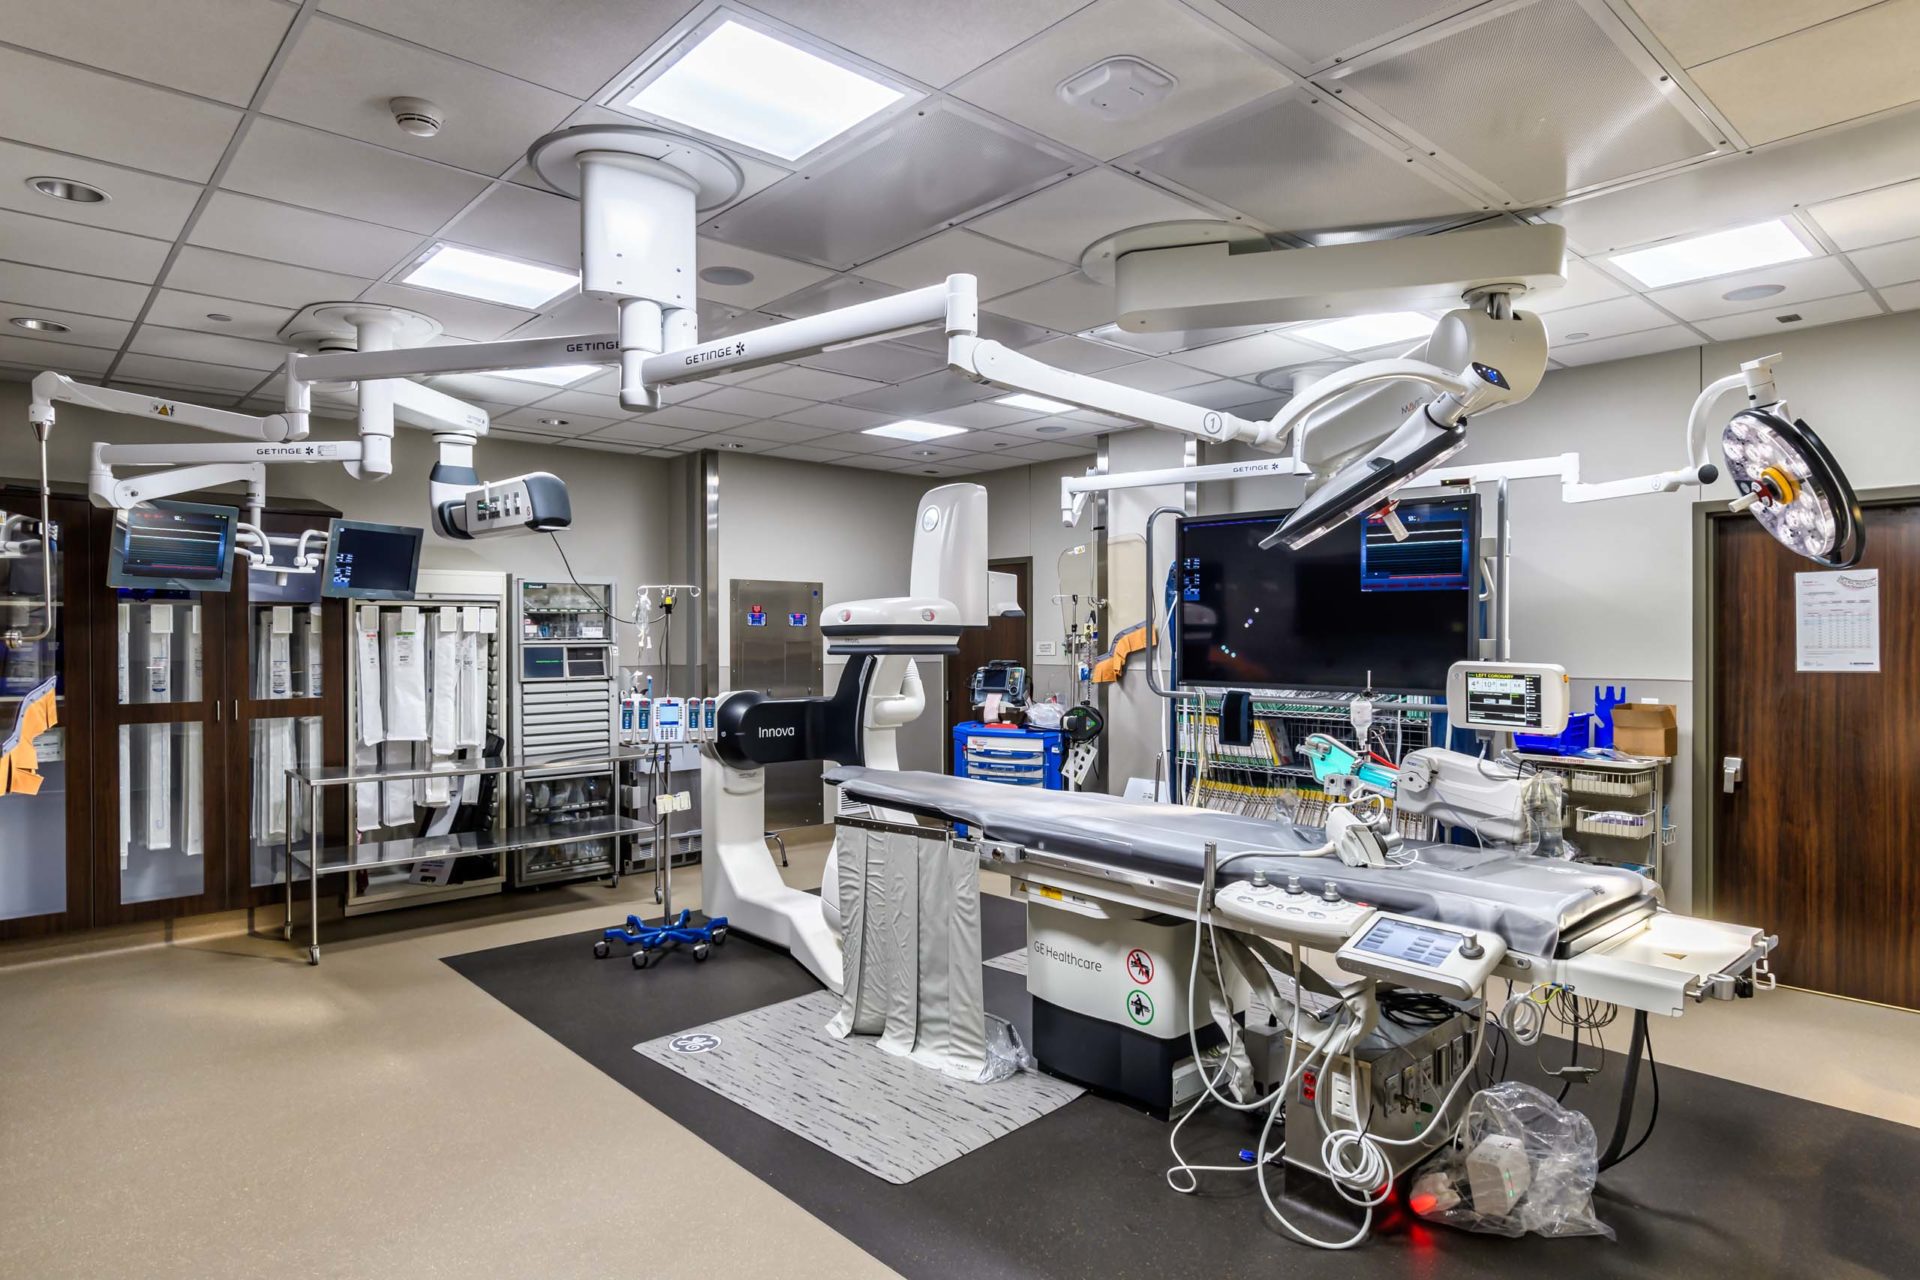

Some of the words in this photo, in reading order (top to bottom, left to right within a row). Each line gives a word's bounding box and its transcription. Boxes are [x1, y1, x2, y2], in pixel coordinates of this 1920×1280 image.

[685, 346, 732, 365] GETINGE
[1232, 464, 1269, 473] GETINGE
[758, 726, 795, 739] Innova
[1033, 940, 1045, 955] GE
[1046, 945, 1103, 972] Healthcare
